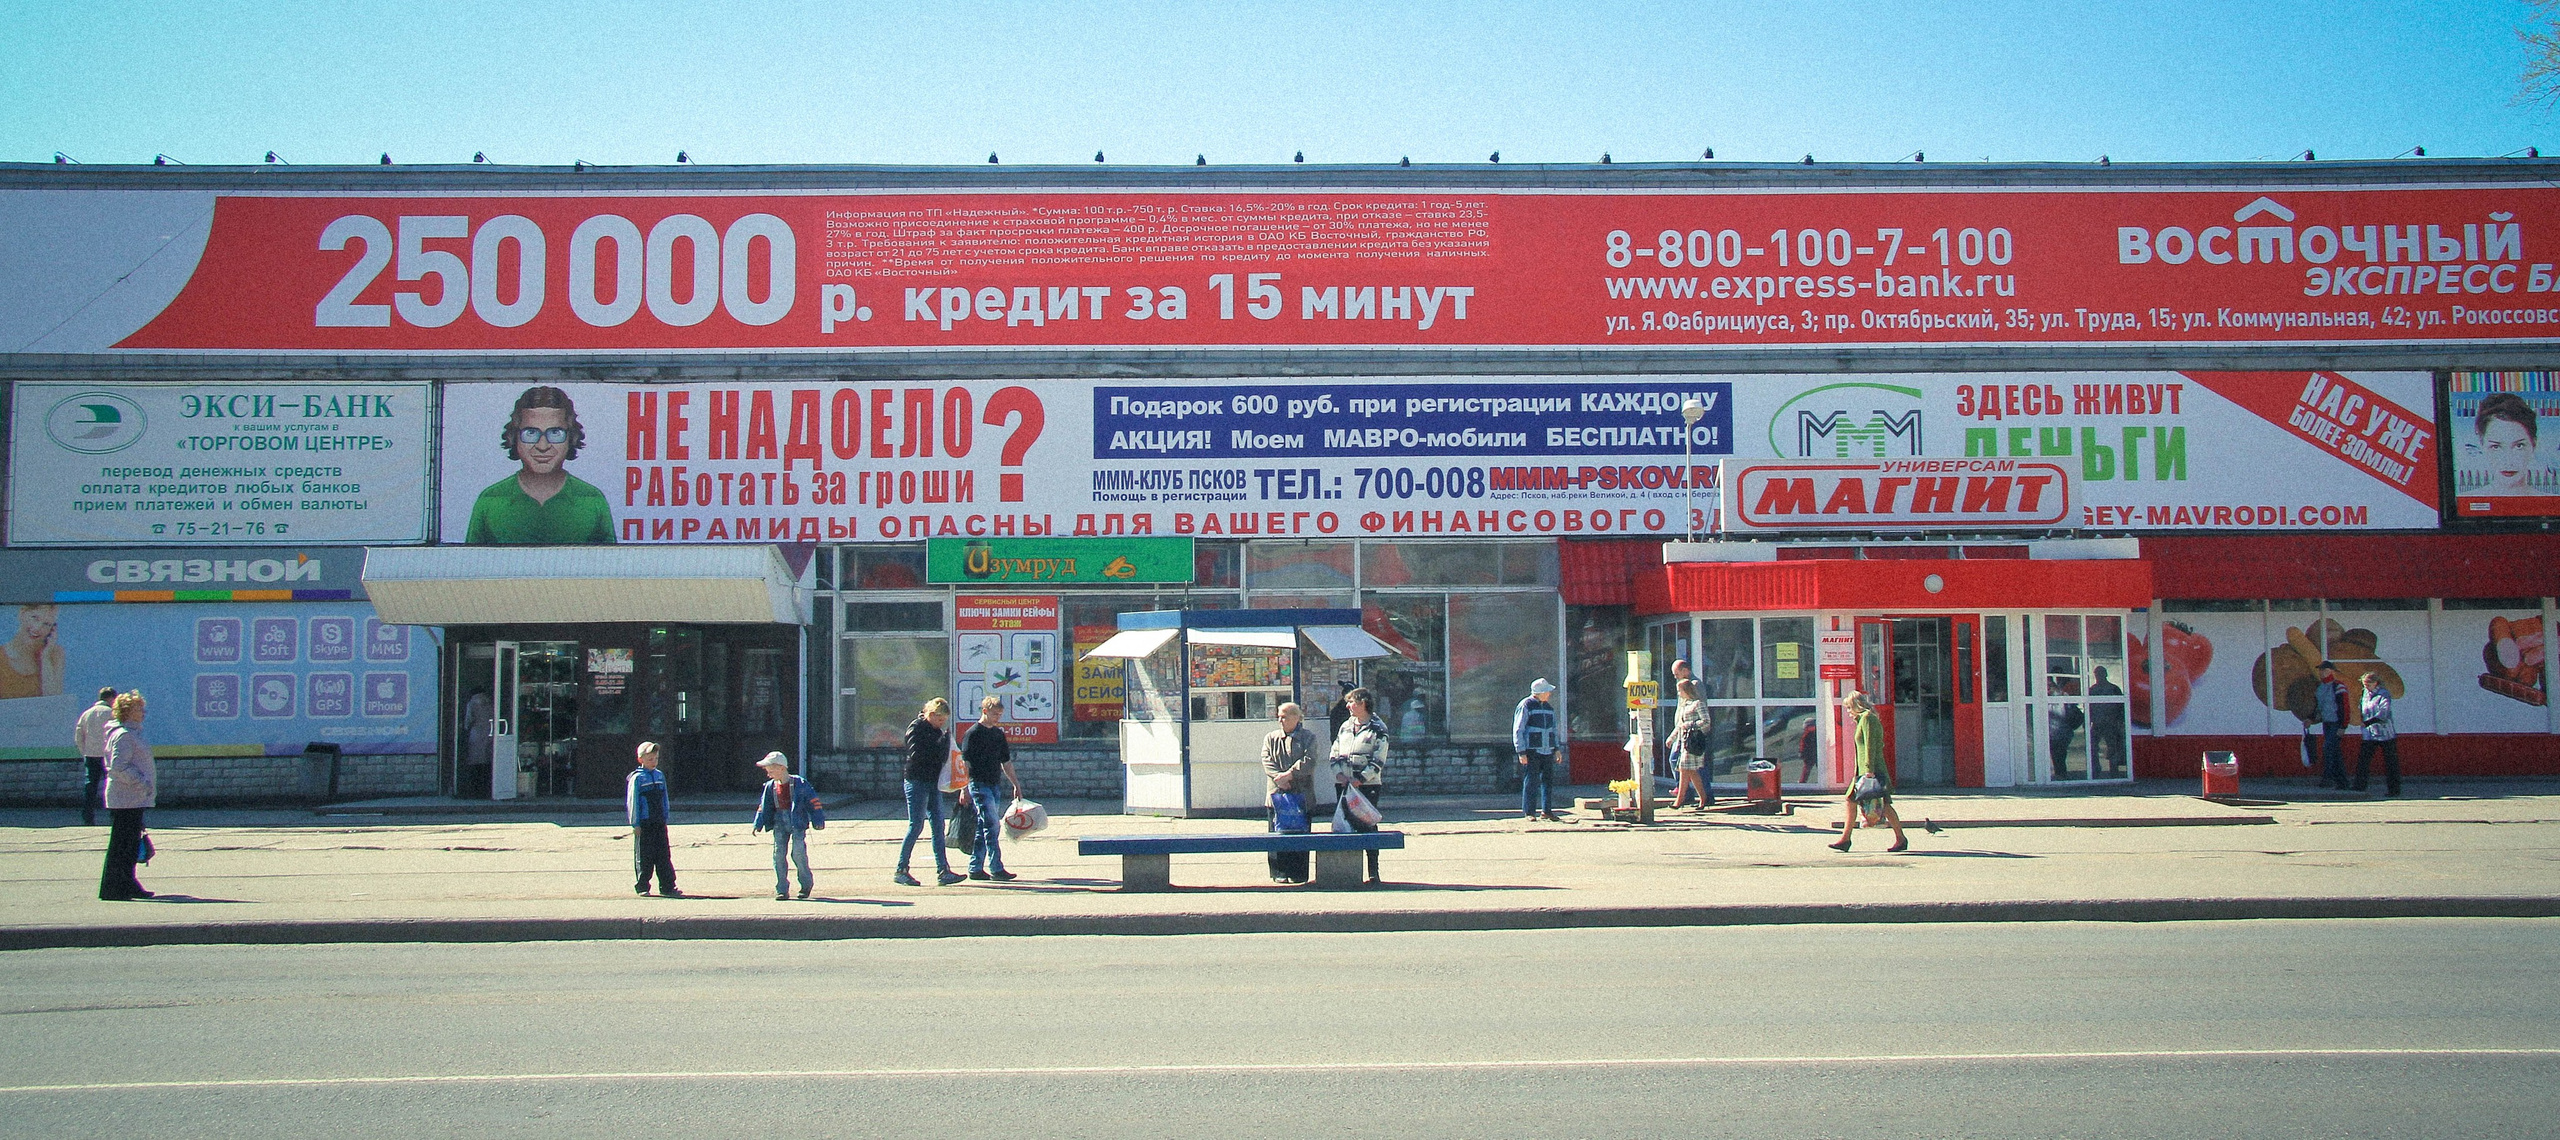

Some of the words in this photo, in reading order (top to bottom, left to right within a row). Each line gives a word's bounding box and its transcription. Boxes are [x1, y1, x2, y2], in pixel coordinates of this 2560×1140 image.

[826, 210, 907, 221] Информация
[908, 210, 924, 218] по
[925, 208, 943, 217] ТП
[945, 207, 1030, 218] «Надежный».
[1084, 205, 1105, 215] 100
[1167, 206, 1178, 216] р.
[1180, 204, 1226, 213] Ставка:
[1307, 203, 1331, 212] год.
[1333, 201, 1363, 212] Срок
[1365, 202, 1418, 212] кредита:
[1464, 201, 1488, 209] лет.
[2118, 197, 2520, 264] восточный
[1606, 228, 2012, 268] 8-800-100-7-100
[316, 215, 546, 327] 250
[569, 213, 796, 327] 000
[825, 267, 853, 278] ОАО
[854, 268, 873, 277] КБ
[874, 266, 958, 277] «Восточный»
[2304, 264, 2516, 296] ЭКСПРЕСС
[2527, 264, 2560, 292] Б
[1605, 268, 2014, 305] www.express-bank.ru
[822, 284, 872, 333] р.
[905, 287, 1110, 330] кредит
[1126, 287, 1186, 319] за
[1209, 273, 1282, 319] 15
[1302, 287, 1474, 330] минут
[1606, 316, 1635, 335] ул.
[1642, 311, 1794, 335] Я.Фабрициуса,
[1802, 310, 1818, 332] 3;
[1825, 315, 1855, 333] пр.
[1862, 309, 1998, 333] Октябрьский,
[2006, 310, 2034, 332] 35;
[2042, 317, 2069, 333] ул.
[2077, 308, 2141, 332] Труда,
[2149, 308, 2176, 330] 15;
[2182, 313, 2211, 332] ул.
[2218, 308, 2374, 331] Коммунальная,
[2382, 307, 2410, 328] 42;
[2417, 311, 2445, 329] ул.
[2453, 306, 2558, 324] Рокоссовс
[1111, 396, 1222, 419] Подарок
[1232, 395, 1278, 414] 600
[1288, 394, 1339, 418] руб.
[1350, 399, 1396, 417] при
[1406, 398, 1571, 417] регистрации
[1957, 385, 2063, 420] ЗДЕСЬ
[2074, 384, 2183, 414] ЖИВУТ
[242, 423, 281, 432] вашим
[283, 423, 329, 434] услугам
[626, 391, 690, 460] НЕ
[2288, 404, 2345, 448] БОЛЕЕ
[2300, 372, 2365, 427] НАС
[2361, 405, 2431, 463] УЖЕ
[177, 436, 298, 451] «ТОРГОВОМ
[305, 436, 392, 452] ЦЕНТРЕ»
[1110, 431, 1211, 453] АКЦИЯ!
[1232, 430, 1303, 448] Моем
[1325, 428, 1526, 447] МАВРО-мобили
[1547, 426, 1718, 447] БЕСПЛАТНО!
[1799, 410, 1922, 457] МММ
[100, 466, 174, 481] перевод
[178, 466, 266, 480] денежных
[273, 466, 342, 480] средств
[1882, 460, 2015, 473] УНИВЕРСАМ
[80, 483, 141, 495] оплата
[148, 483, 228, 497] кредитов
[234, 480, 294, 494] любых
[301, 480, 361, 494] банков
[812, 469, 847, 506] за
[859, 469, 974, 509] гроши
[1093, 470, 1183, 490] МММ-КЛУБ
[1189, 470, 1246, 489] ПСКОВ
[1254, 469, 1341, 499] ТЕЛ.:
[1355, 467, 1485, 499] 700-008
[72, 500, 127, 514] прием
[134, 498, 215, 511] платежей
[222, 500, 233, 511] и
[239, 497, 293, 511] обмен
[300, 499, 368, 511] валюты
[1092, 491, 1147, 503] Помощь
[1162, 492, 1247, 504] регистрации
[1754, 476, 2052, 514] МАГНИТ
[176, 521, 265, 536] 75–21–76
[623, 517, 857, 542] ПИРАМИДЫ
[880, 514, 1052, 538] ОПАСНЫ
[1074, 513, 1152, 536] ДЛЯ
[1174, 511, 1339, 534] ВАШЕГО
[1360, 509, 1666, 532] ФИНАНСОВОГО
[88, 553, 322, 583] СВЯЗНОЙ
[968, 548, 1077, 579] Изумруд
[959, 607, 990, 618] КЛЮЧИ
[992, 607, 1021, 618] ЗАМКИ
[1022, 606, 1055, 618] СЕЙФЫ
[1018, 598, 1040, 606] ЦЕНТР
[998, 619, 1022, 628] этаж
[261, 645, 289, 656] Soft
[315, 644, 347, 656] Skype
[371, 643, 402, 655] MMS
[204, 701, 229, 714] ICQ
[316, 700, 342, 711] GPS
[368, 700, 403, 711] iPhone
